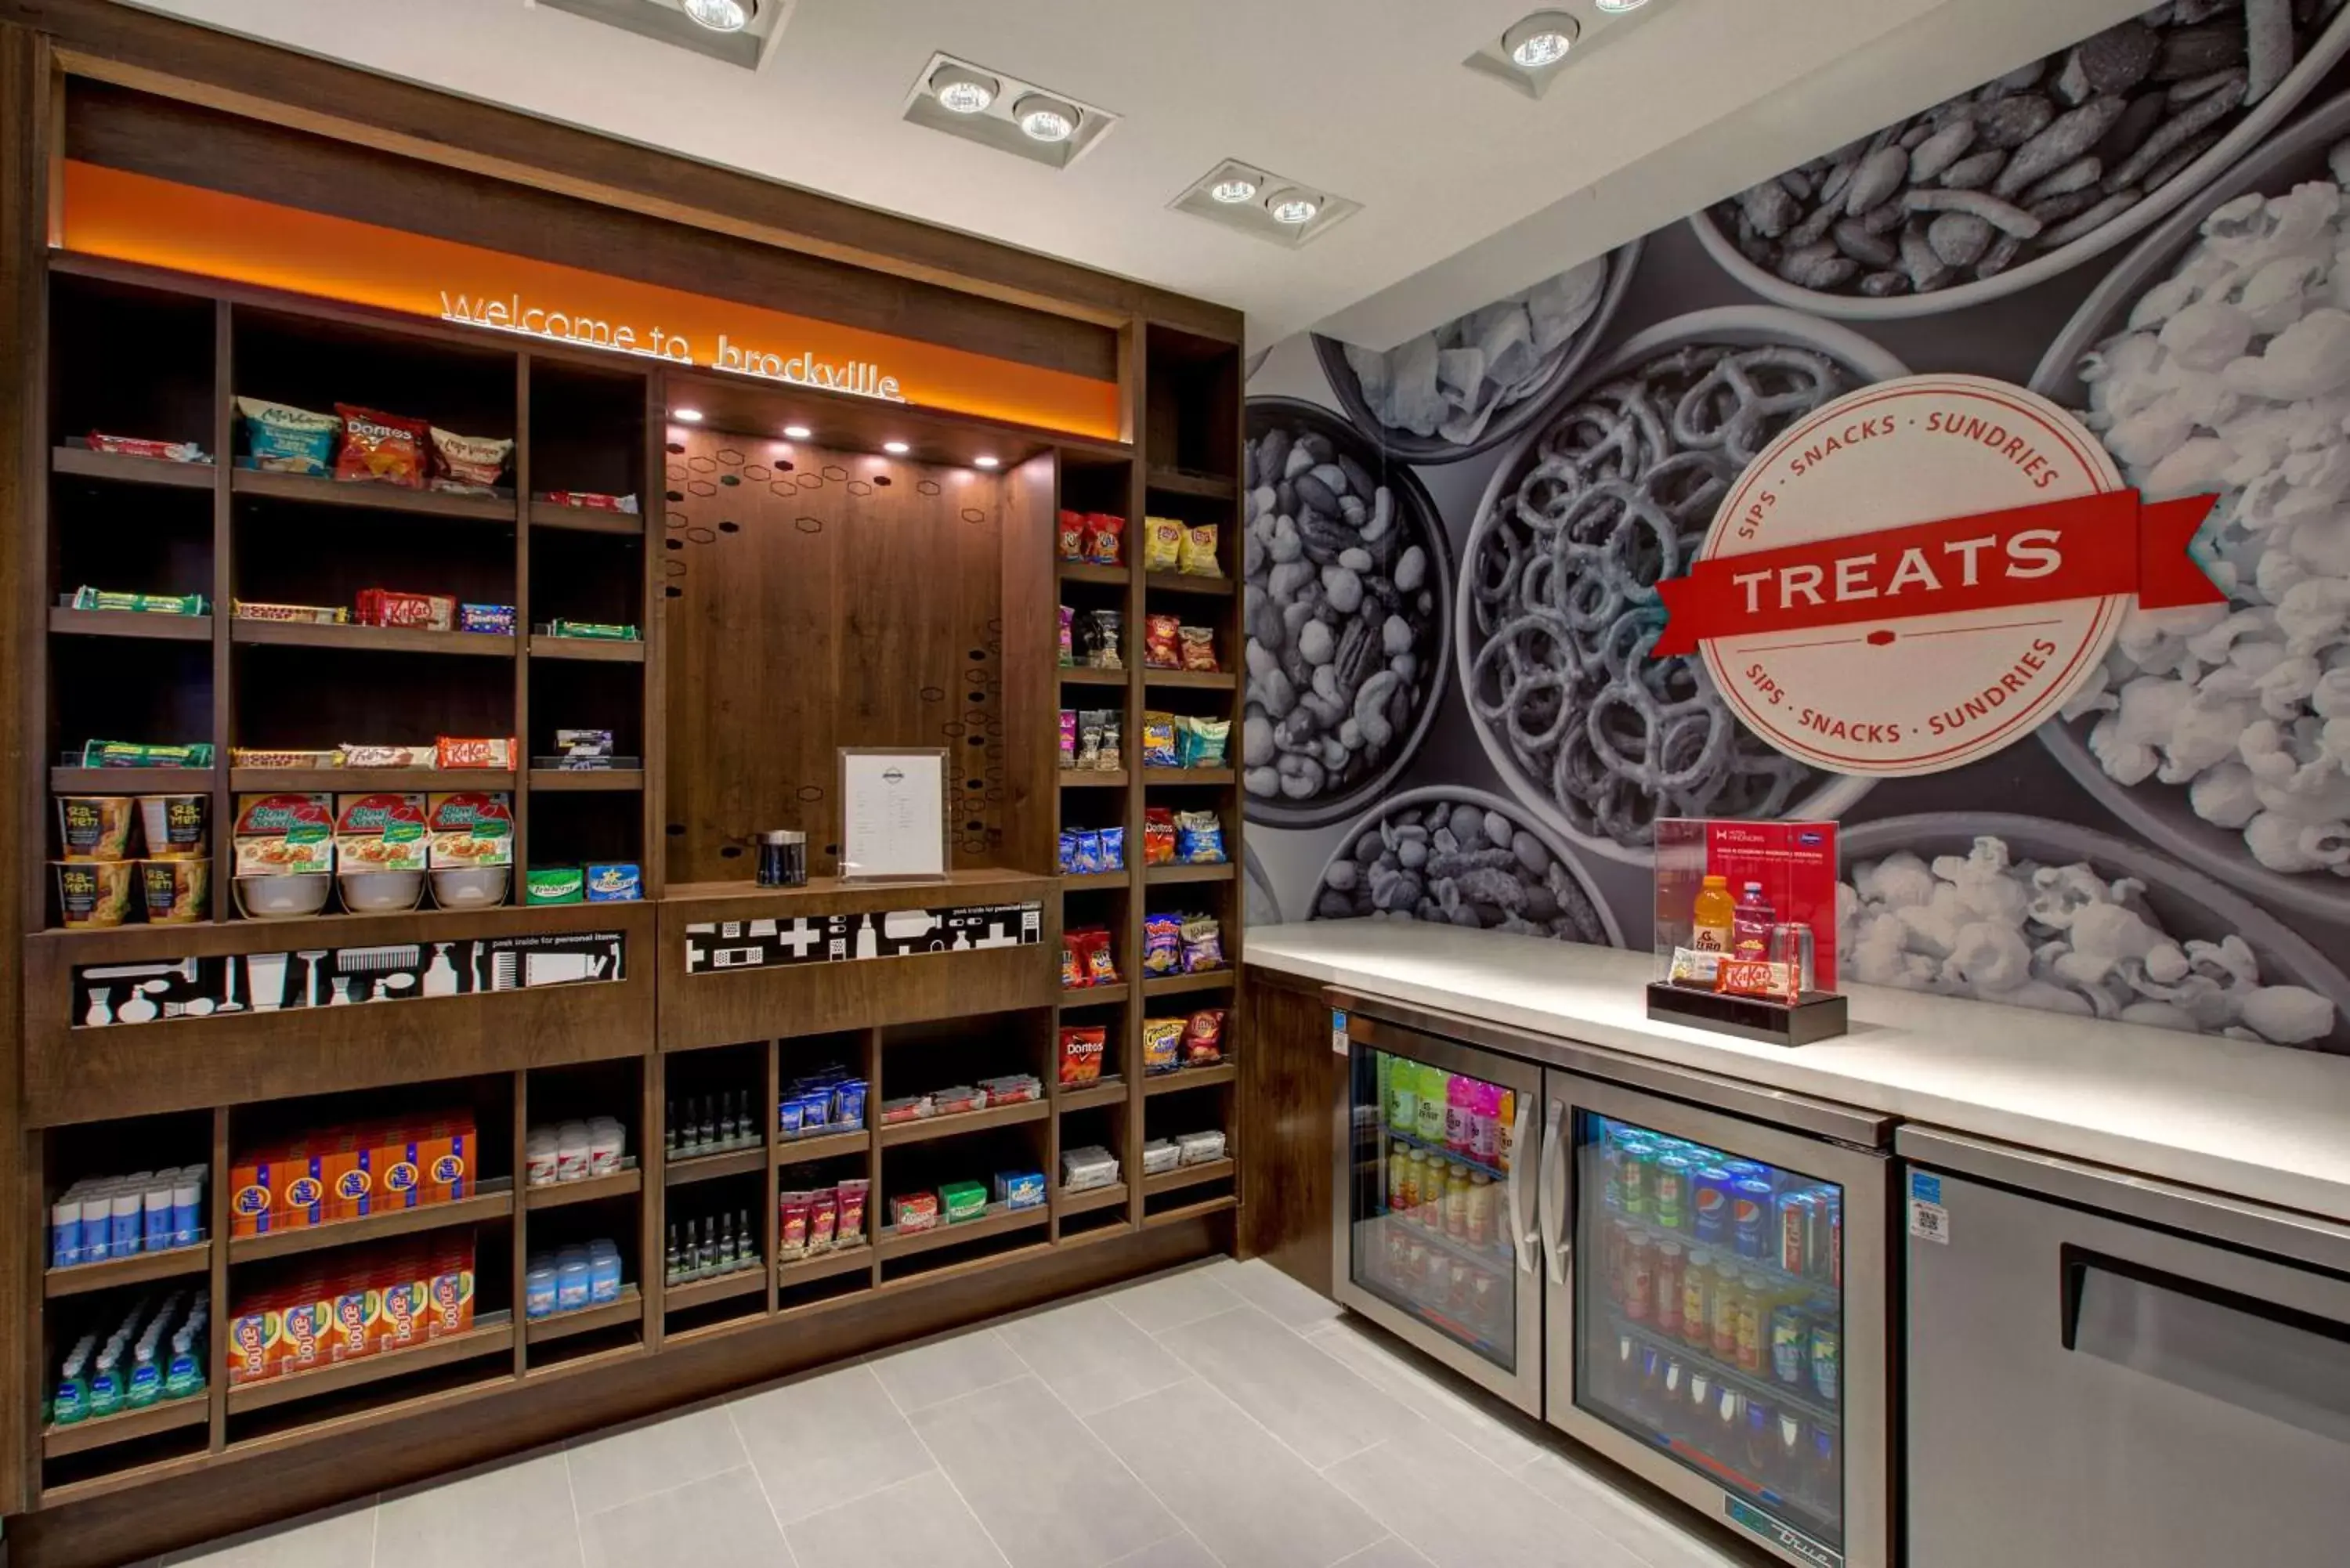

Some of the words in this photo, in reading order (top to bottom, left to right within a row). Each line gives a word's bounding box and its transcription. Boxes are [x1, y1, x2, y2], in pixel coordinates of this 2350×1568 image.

[440, 291, 636, 349] welcome
[649, 325, 689, 358] to
[717, 334, 901, 399] brockville
[348, 421, 413, 440] Doritos
[1738, 490, 1776, 540] SIPS
[1790, 415, 1895, 476] SNACKS
[1925, 411, 2059, 489] SUNDRIES
[1733, 529, 2063, 614] TREATS
[1745, 663, 1786, 705] SIPS
[1798, 708, 1900, 744] SNACKS
[1928, 638, 2058, 736] SUNDRIES
[555, 934, 592, 945] personal
[1067, 1042, 1104, 1055] Doritos
[392, 1165, 411, 1189] Tide
[439, 1158, 456, 1181] Tide
[294, 1180, 312, 1205] Tide
[345, 1172, 364, 1198] Tide
[241, 1188, 261, 1213] Tide
